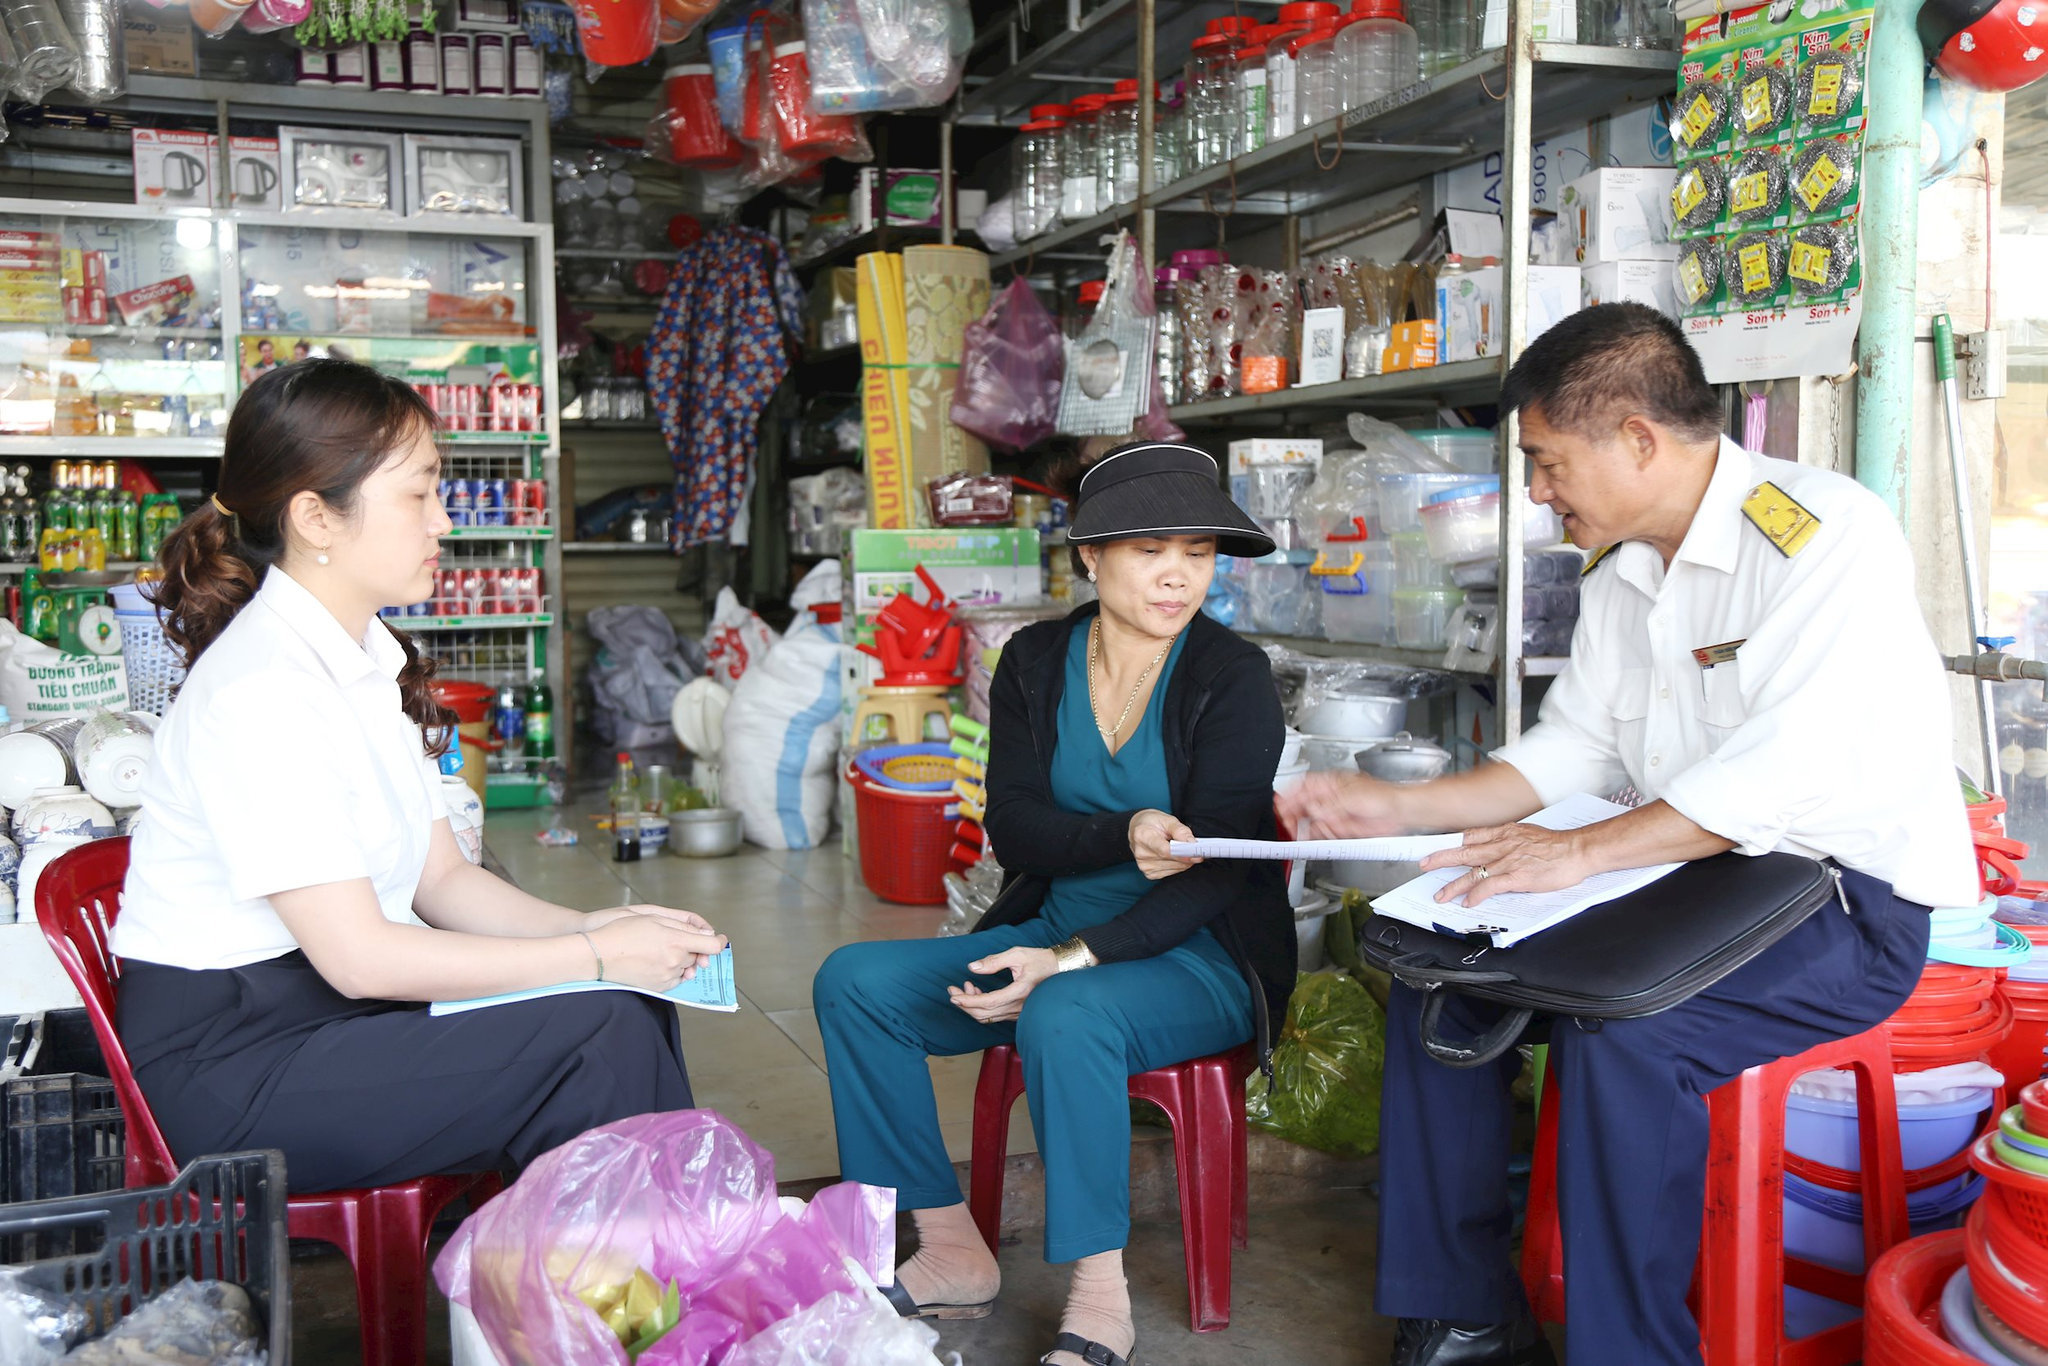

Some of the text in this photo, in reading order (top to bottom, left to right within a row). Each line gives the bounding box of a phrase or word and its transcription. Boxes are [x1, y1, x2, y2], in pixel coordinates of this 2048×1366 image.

[1803, 31, 1829, 46] Kim
[1742, 47, 1764, 61] Kim
[1682, 61, 1704, 76] Kim
[160, 133, 206, 145] DIAMOND
[233, 139, 277, 150] DIAMOND
[1533, 142, 1547, 204] 9001
[130, 282, 177, 305] ChocoPie
[27, 702, 70, 711] STANDARD
[101, 692, 127, 706] SUGAR
